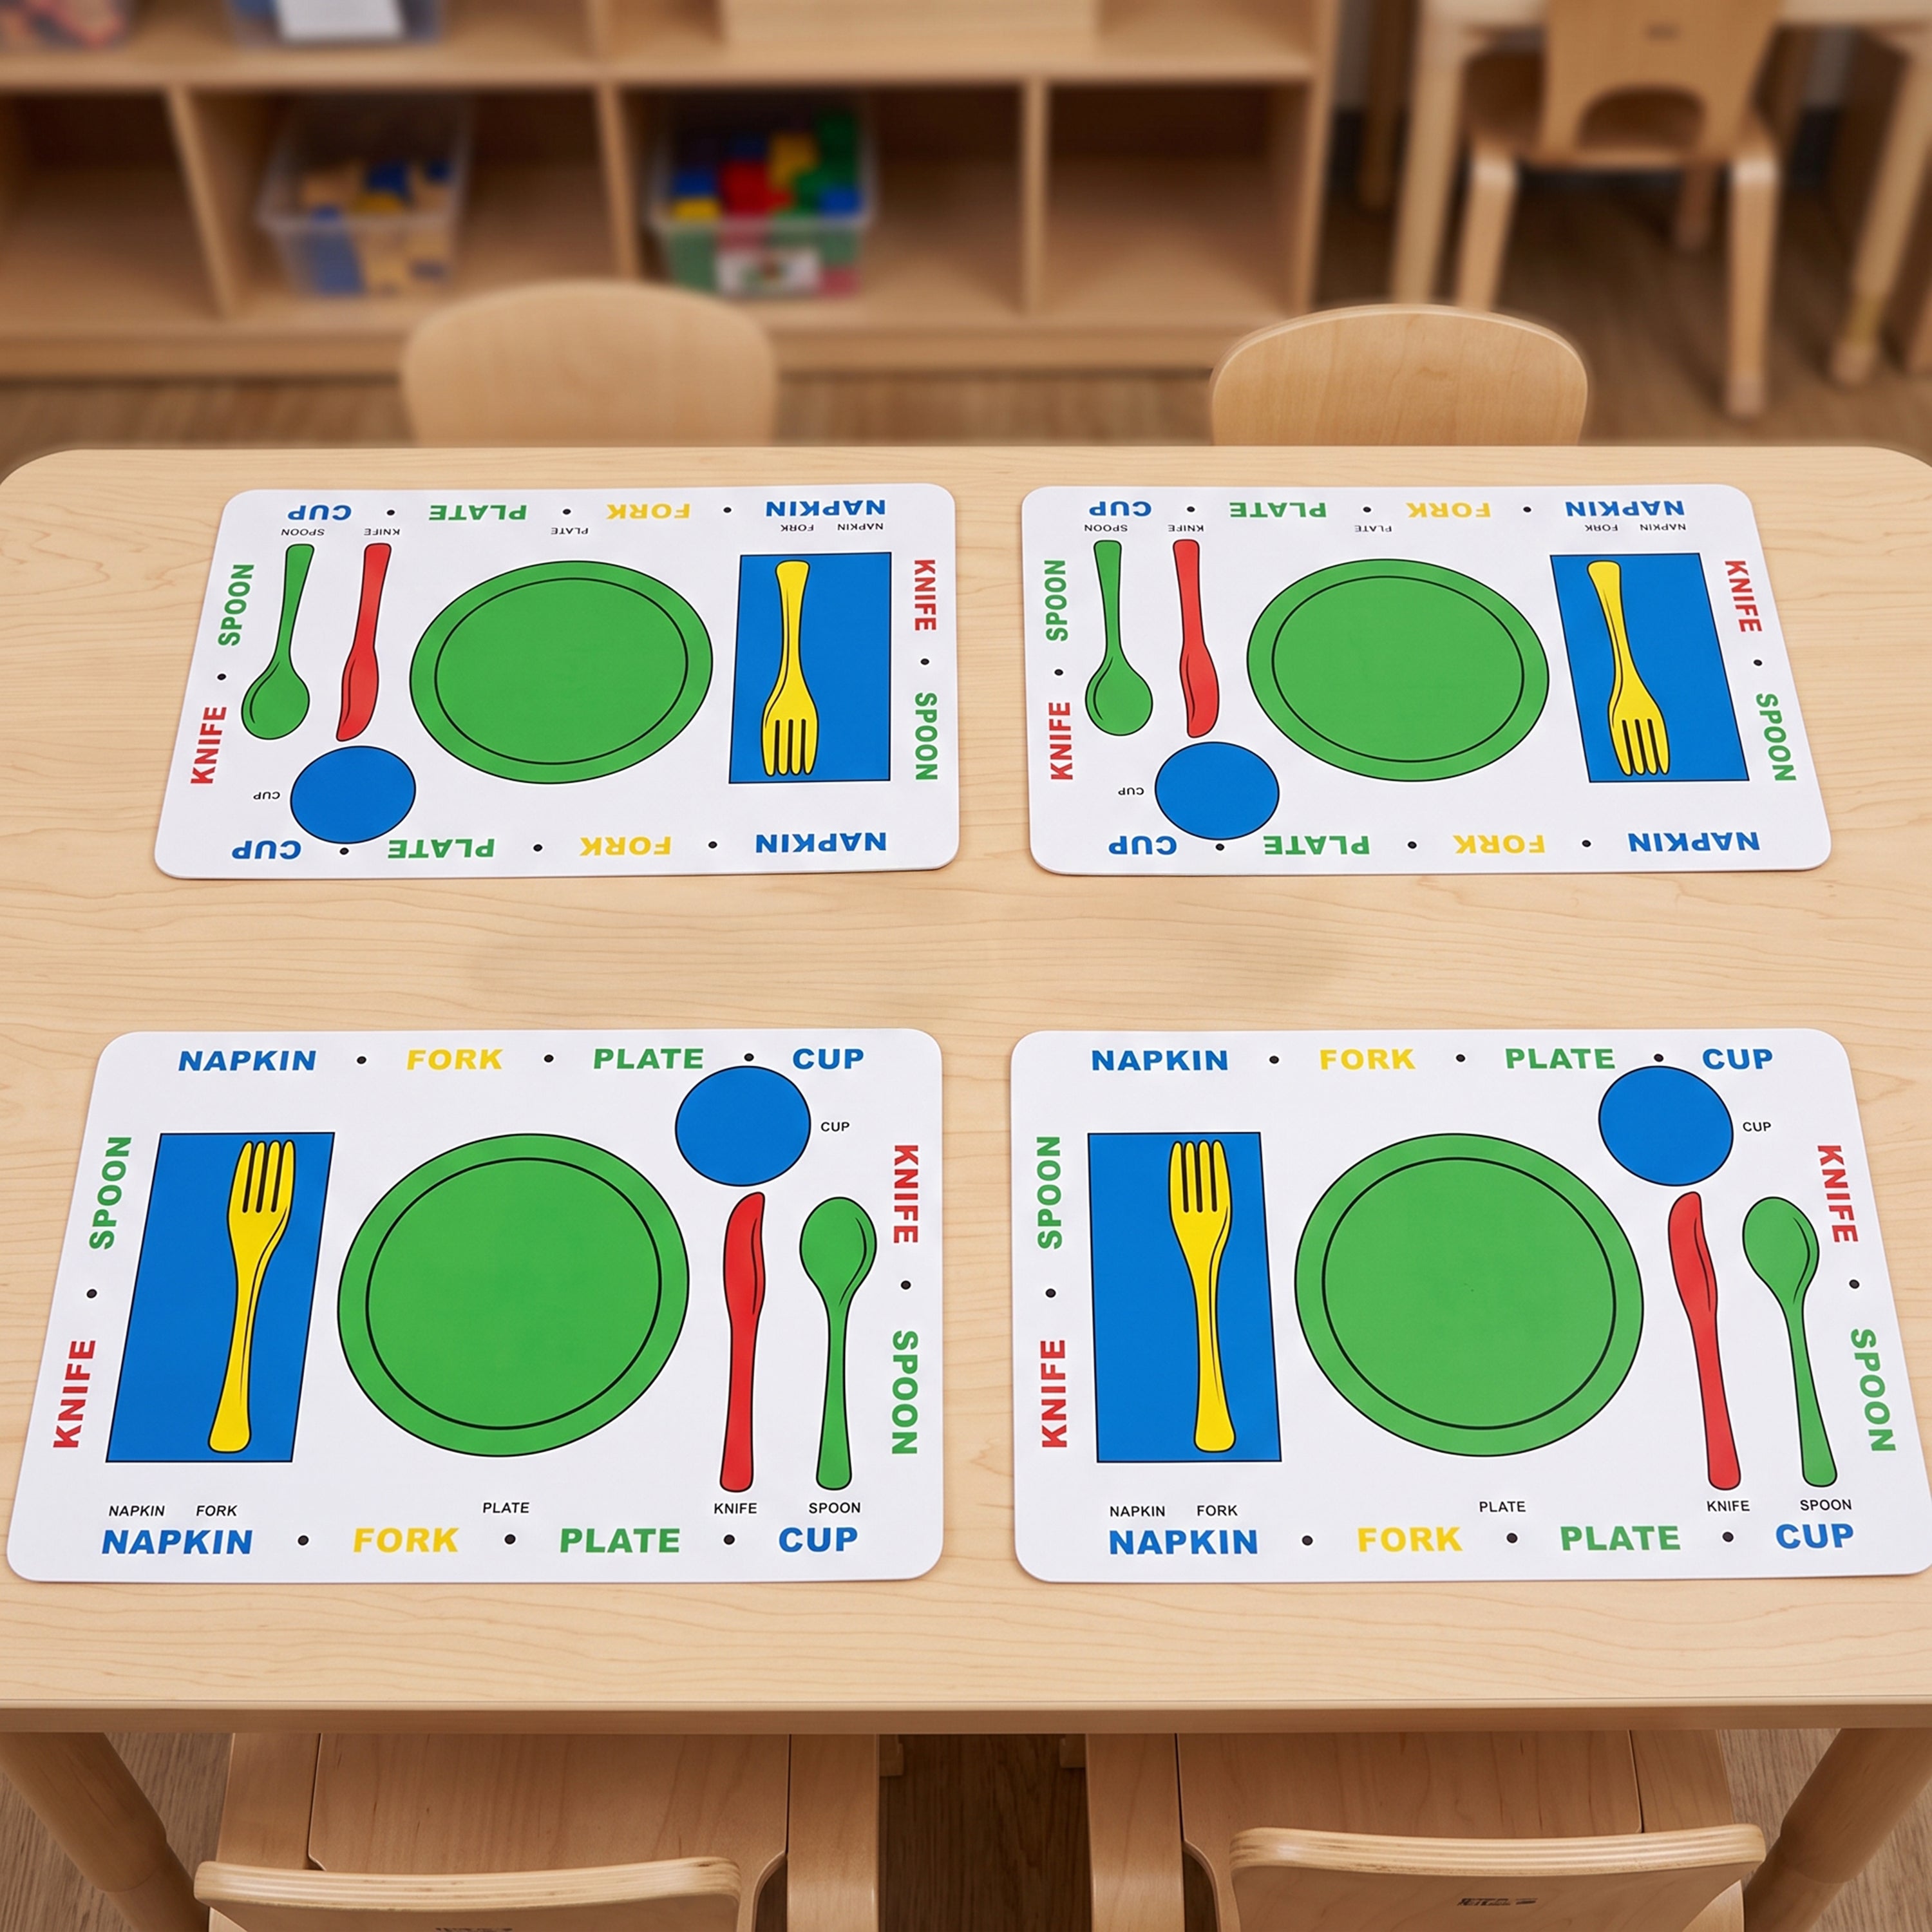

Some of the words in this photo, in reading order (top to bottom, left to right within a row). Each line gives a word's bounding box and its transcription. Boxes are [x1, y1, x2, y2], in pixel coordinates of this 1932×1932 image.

[287, 504, 352, 521] CUP
[428, 504, 527, 521] PLATE
[607, 503, 690, 520] FORK
[766, 499, 886, 517] NAPKIN
[1088, 500, 1152, 517] CUP
[1229, 502, 1327, 518] PLATE
[1406, 502, 1491, 518] FORK
[1565, 500, 1685, 517] NAPKIN
[281, 528, 325, 536] SPOON
[551, 527, 589, 535] PLATE
[781, 524, 814, 532] FORK
[837, 522, 884, 531] NAPKIN
[1584, 524, 1618, 532] FORK
[1640, 523, 1687, 531] NAPKIN
[914, 559, 937, 631] KNIFE
[1044, 560, 1068, 642] SPOON
[190, 706, 227, 784] KNIFE
[217, 564, 254, 647] SPOON
[1725, 560, 1762, 632] KNIFE
[1756, 693, 1796, 781] SPOON
[914, 692, 938, 781] SPOON
[1048, 702, 1074, 781] KNIFE
[252, 791, 281, 800] CUP
[1117, 787, 1144, 796] CUP
[231, 840, 302, 860] CUP
[387, 838, 495, 859] PLATE
[580, 836, 672, 857] FORK
[755, 832, 887, 853] NAPKIN
[1108, 835, 1177, 856] CUP
[1263, 835, 1370, 855] PLATE
[1453, 834, 1546, 854] FORK
[1627, 831, 1761, 853] NAPKIN
[178, 1050, 317, 1072] NAPKIN
[406, 1048, 503, 1071] FORK
[593, 1048, 704, 1070] PLATE
[792, 1048, 864, 1070] CUP
[1092, 1050, 1228, 1071] NAPKIN
[1320, 1048, 1416, 1071] FORK
[1505, 1048, 1616, 1070] PLATE
[1702, 1048, 1773, 1070] CUP
[820, 1121, 850, 1132] CUP
[1742, 1121, 1772, 1132] CUP
[893, 1144, 919, 1244] KNIFE
[1036, 1136, 1063, 1250] SPOON
[52, 1340, 96, 1448] KNIFE
[88, 1137, 132, 1250] SPOON
[1817, 1145, 1859, 1243] KNIFE
[1850, 1329, 1897, 1452] SPOON
[891, 1330, 919, 1455] SPOON
[1039, 1340, 1068, 1448] KNIFE
[108, 1505, 166, 1517] NAPKIN
[196, 1504, 238, 1517] FORK
[482, 1502, 530, 1514] PLATE
[714, 1502, 757, 1515] KNIFE
[808, 1502, 861, 1514] SPOON
[1110, 1505, 1166, 1517] NAPKIN
[1197, 1504, 1238, 1517] FORK
[1479, 1501, 1526, 1513] PLATE
[1707, 1500, 1750, 1512] KNIFE
[1800, 1499, 1852, 1511] SPOON
[101, 1530, 253, 1555] NAPKIN
[353, 1527, 459, 1553] FORK
[560, 1528, 680, 1553] PLATE
[779, 1526, 858, 1553] CUP
[1109, 1529, 1258, 1555] NAPKIN
[1357, 1526, 1463, 1553] FORK
[1560, 1525, 1681, 1551] PLATE
[1776, 1523, 1854, 1549] CUP
